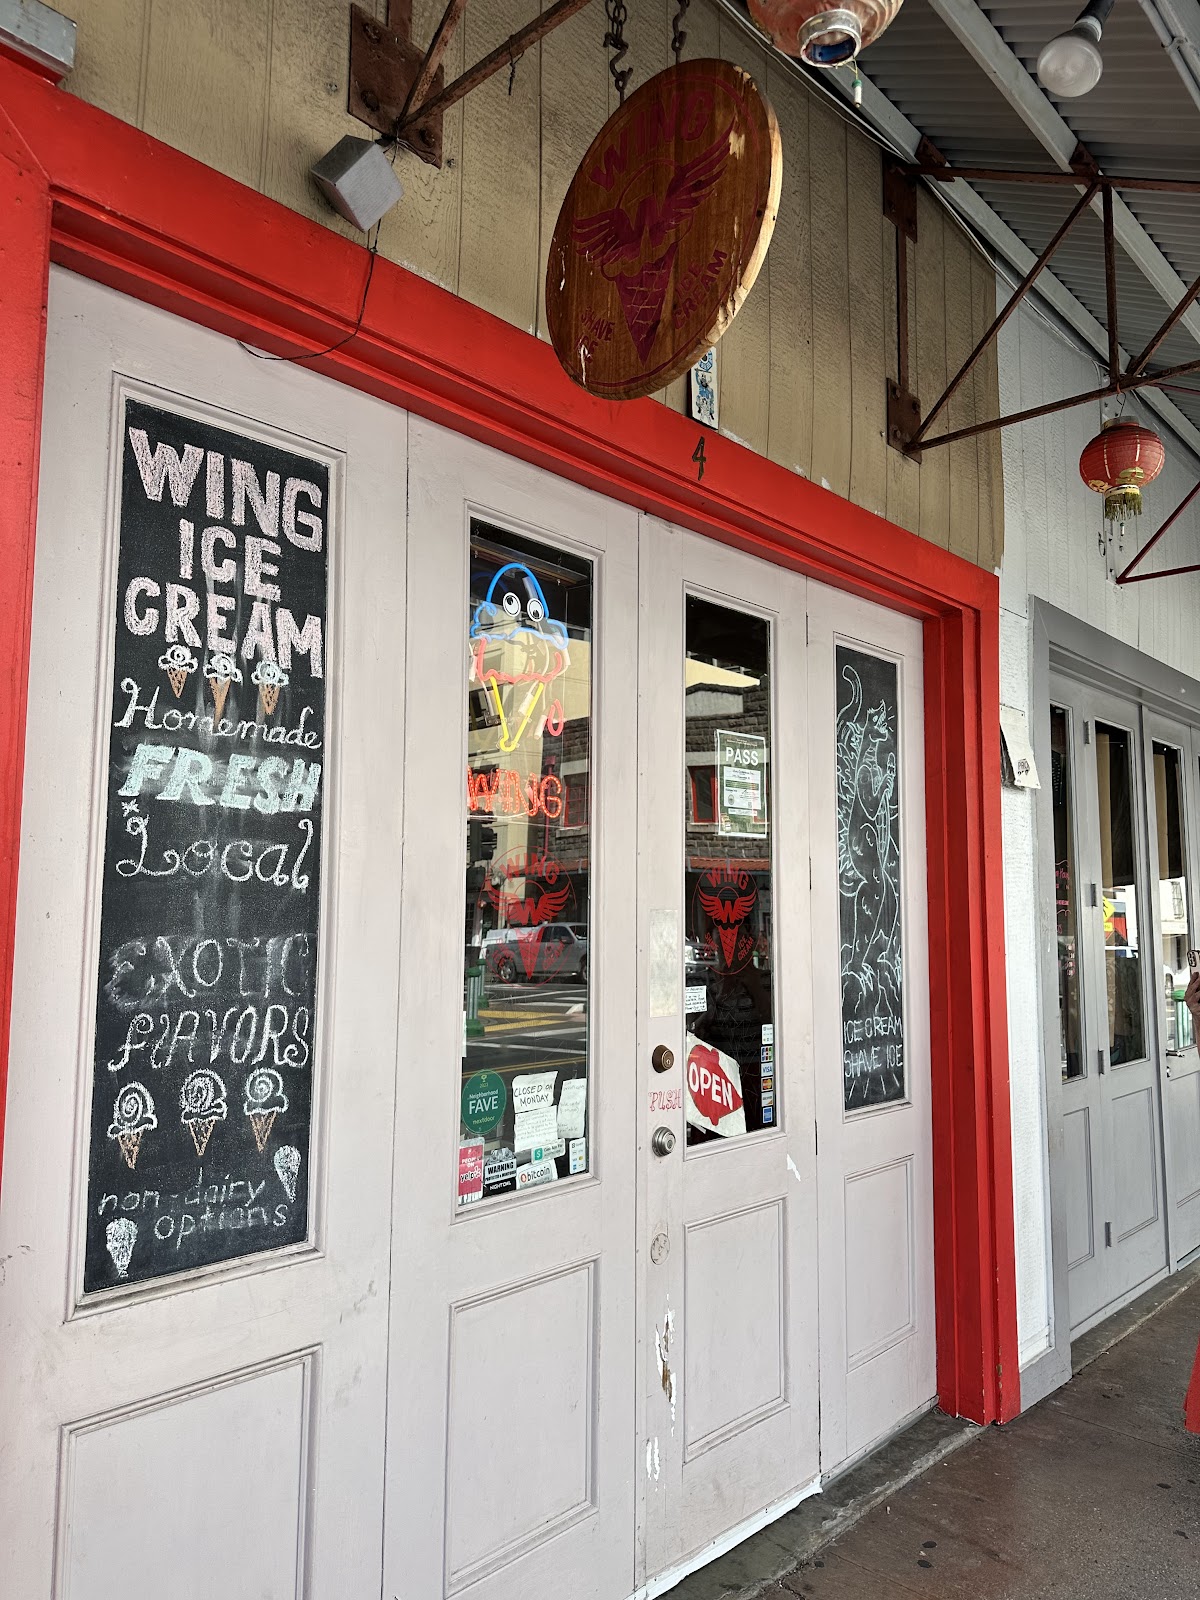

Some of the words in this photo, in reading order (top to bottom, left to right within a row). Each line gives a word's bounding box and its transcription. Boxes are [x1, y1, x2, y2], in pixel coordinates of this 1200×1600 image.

[588, 90, 715, 192] WING
[672, 249, 728, 329] CREAM
[692, 436, 706, 481] 4
[128, 426, 323, 552] WING
[178, 518, 282, 602] ICE
[124, 576, 323, 678] CREAM
[114, 677, 322, 749] Homemade
[726, 747, 758, 766] PASS
[117, 743, 322, 815] FRESH
[468, 764, 562, 818] WING
[500, 852, 559, 885] WING
[707, 863, 749, 890] WING
[843, 1020, 864, 1044] ICE
[864, 1015, 903, 1039] CREAM
[762, 1065, 773, 1073] VISA
[844, 1046, 882, 1079] SHAVE
[886, 1044, 903, 1069] ICE
[513, 1084, 543, 1098] CLOSED
[519, 1094, 550, 1107] MONDAY
[648, 1088, 682, 1112] PUSH
[688, 1061, 734, 1111] OPEN
[469, 1095, 499, 1115] FAVE
[472, 1116, 495, 1125] nextdoor
[460, 1171, 475, 1183] yelp
[487, 1161, 514, 1175] WARNING
[526, 1165, 550, 1182] bitcoin
[154, 1203, 288, 1250] options
